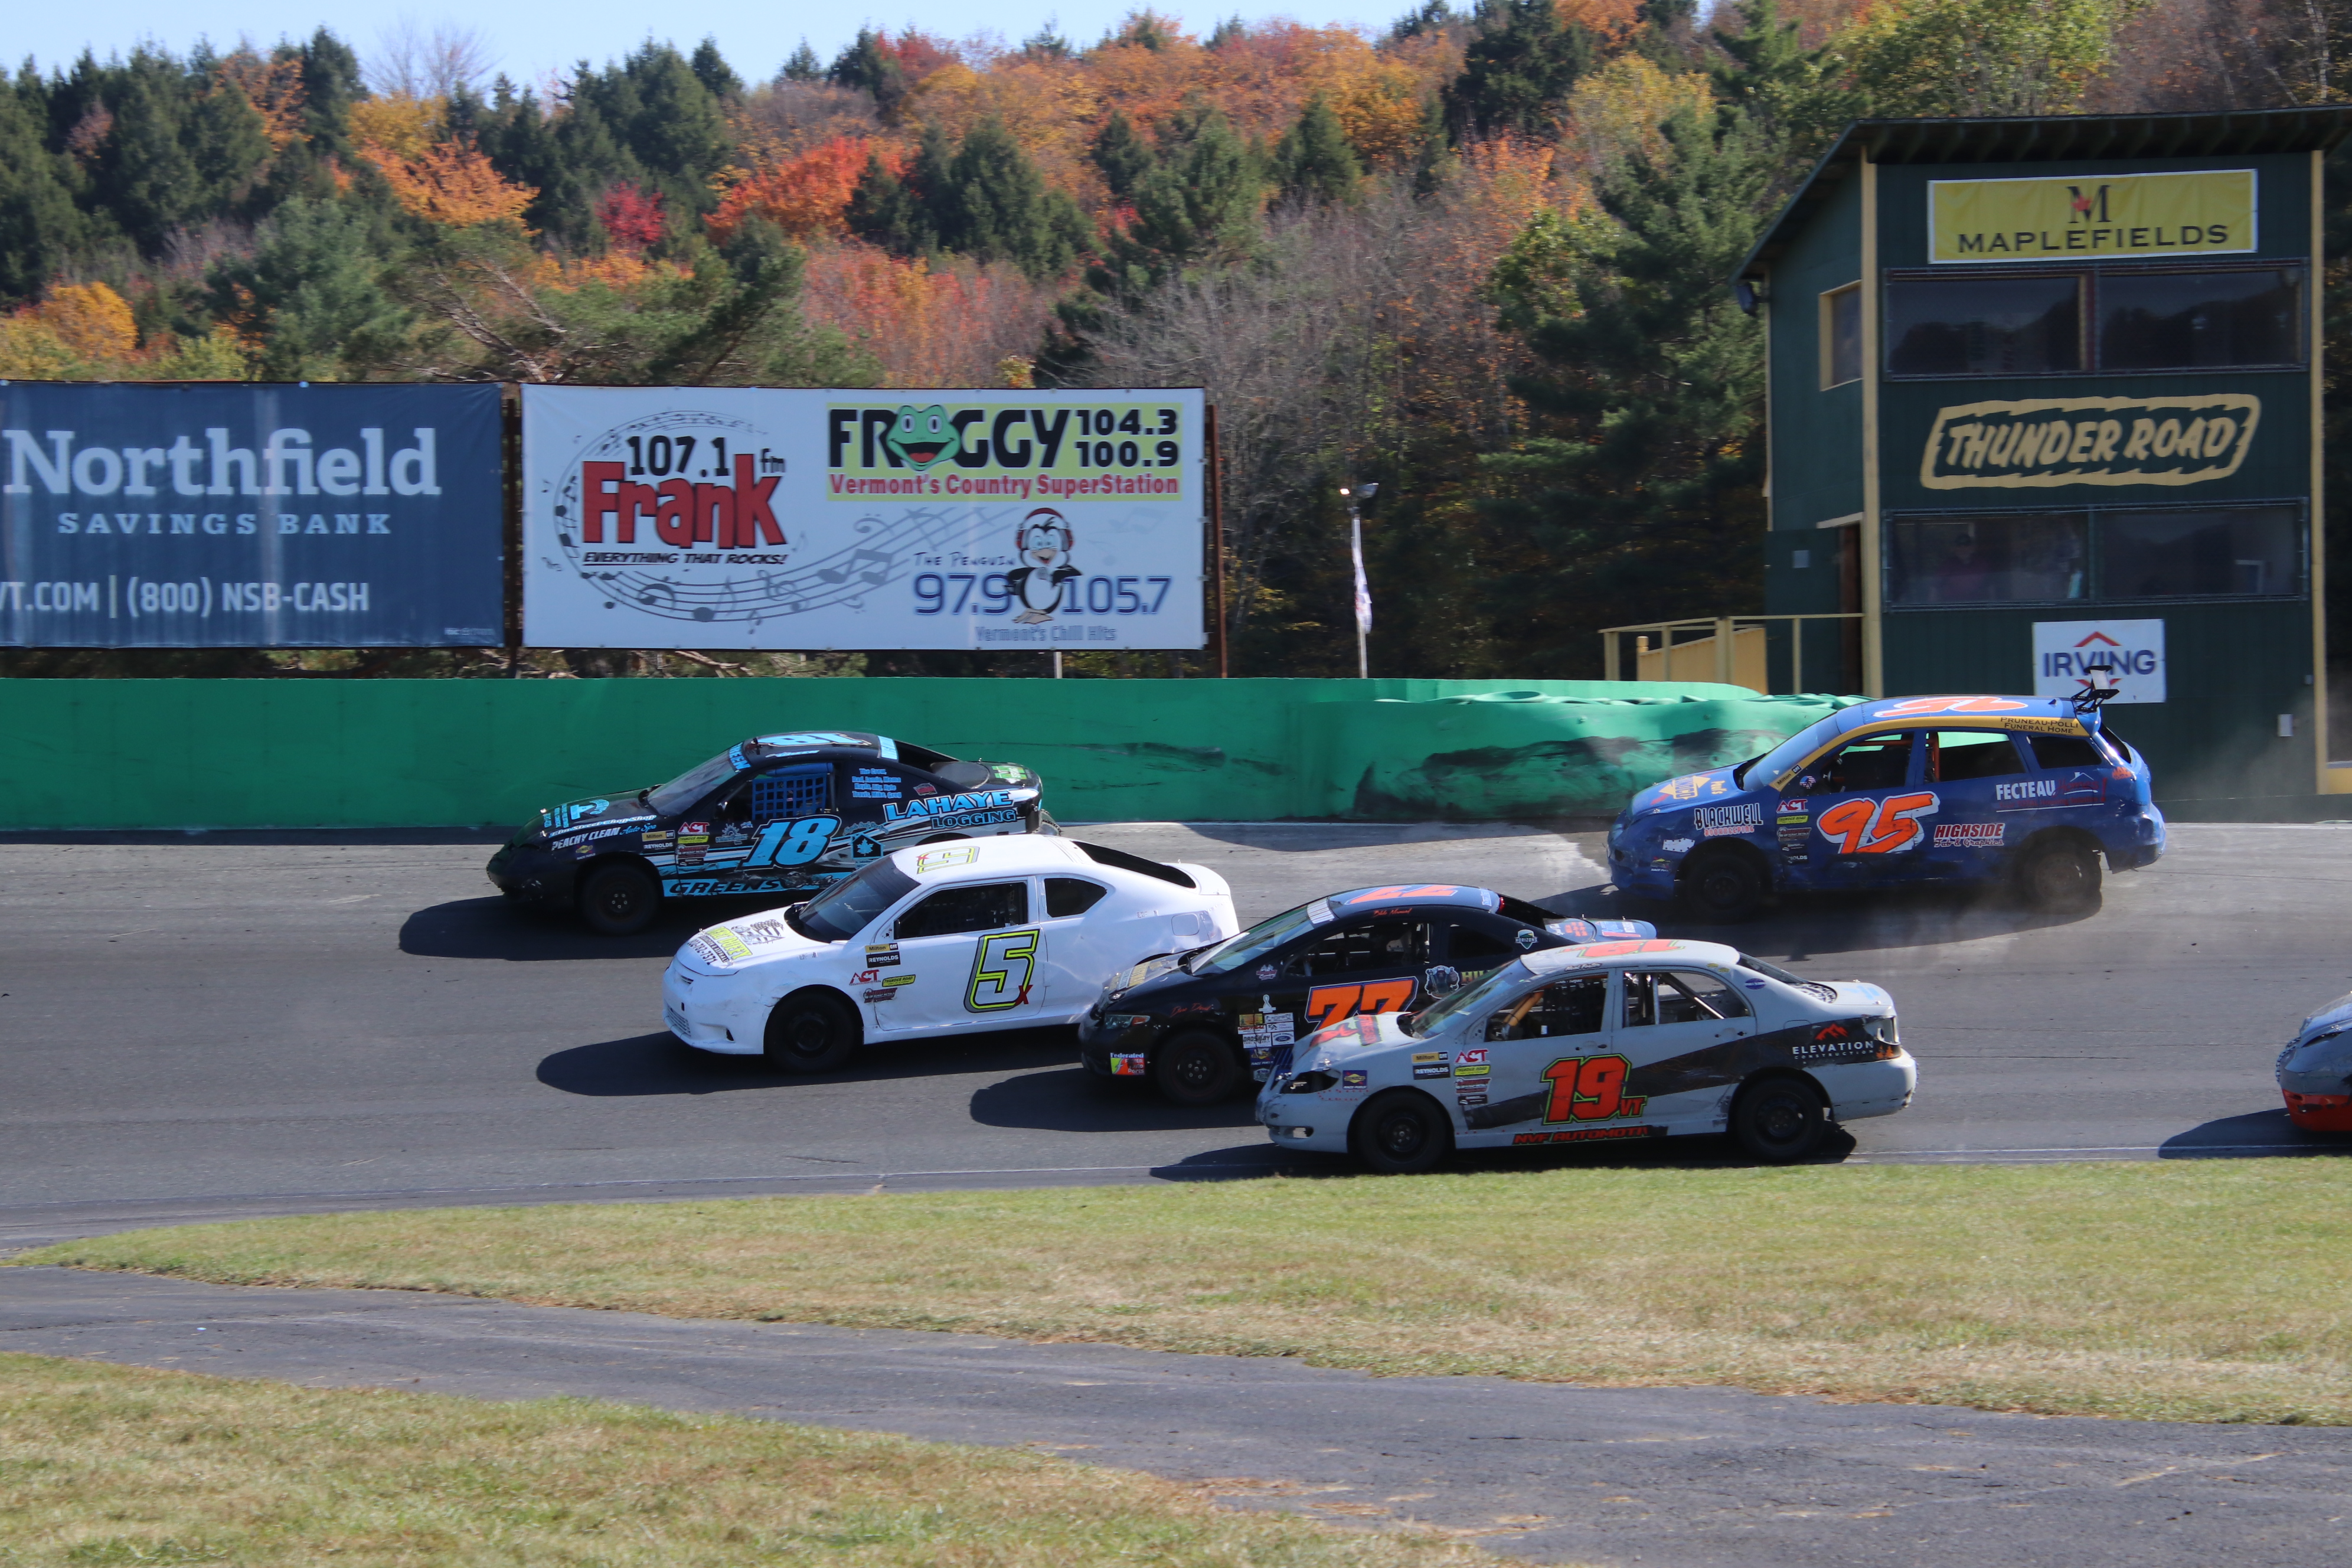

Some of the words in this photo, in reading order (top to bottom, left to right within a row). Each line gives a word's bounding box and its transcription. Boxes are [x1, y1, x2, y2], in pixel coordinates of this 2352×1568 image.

[1958, 224, 2229, 253] MAPLEFIELDS
[1076, 408, 1178, 436] 104.3
[1075, 440, 1179, 468] 100.9
[1946, 419, 2122, 468] THUNDER
[2124, 417, 2237, 460] ROAD
[3, 427, 442, 496] Northfield
[626, 435, 729, 477] 107.1
[760, 448, 786, 473] fm
[829, 473, 941, 495] Vermont's
[946, 474, 1033, 499] Country
[1037, 473, 1178, 499] SuperStation
[582, 453, 788, 549] Frank
[58, 512, 258, 535] SAVINGS
[277, 513, 391, 535] BANK
[582, 552, 680, 564] EVERYTHING
[684, 554, 723, 564] THAT
[726, 554, 789, 565] ROCKS!
[126, 577, 213, 619] (800)
[223, 582, 370, 612] NSB-CASH
[913, 572, 1013, 616] 97.9
[1062, 576, 1173, 615] 105.7
[975, 626, 1047, 641] Vermont's
[1050, 626, 1084, 641] Chill
[1087, 626, 1117, 641] Hits
[2043, 650, 2155, 677] IRVING
[2000, 716, 2079, 729] PRUNEAU-POLLI
[2004, 723, 2046, 732] FUNERAL
[2047, 725, 2074, 734] HOME
[1776, 773, 1792, 786] Milton
[1995, 780, 2056, 801] FECTEAU
[629, 814, 657, 822] Shop
[883, 788, 1015, 824] LAHAYE
[1694, 803, 1763, 829] BLACKWELL
[1776, 799, 1808, 813] ACT
[678, 822, 710, 834] ACT
[932, 808, 1018, 830] LOGGING
[1704, 825, 1755, 837] BOOKKEEPING
[1818, 791, 1940, 854] 95
[1934, 823, 2005, 839] HIGHSIDE
[551, 833, 590, 851] PEACHY
[588, 827, 621, 841] CLEAN
[620, 826, 641, 835] Auto
[641, 822, 657, 833] Spa
[737, 815, 841, 870] 18
[1954, 839, 1962, 847] &
[1964, 837, 2005, 848] Graphics
[868, 955, 899, 963] REYNOLDS
[963, 928, 1040, 1014] 5
[850, 969, 880, 984] ACT
[1305, 976, 1419, 1031] 77
[1455, 1048, 1489, 1063] ACT
[1792, 1040, 1874, 1055] ELEVATION
[1794, 1049, 1874, 1060] CONSTRUCTION
[1541, 1054, 1632, 1125] 19
[1514, 1133, 1550, 1144] NVF
